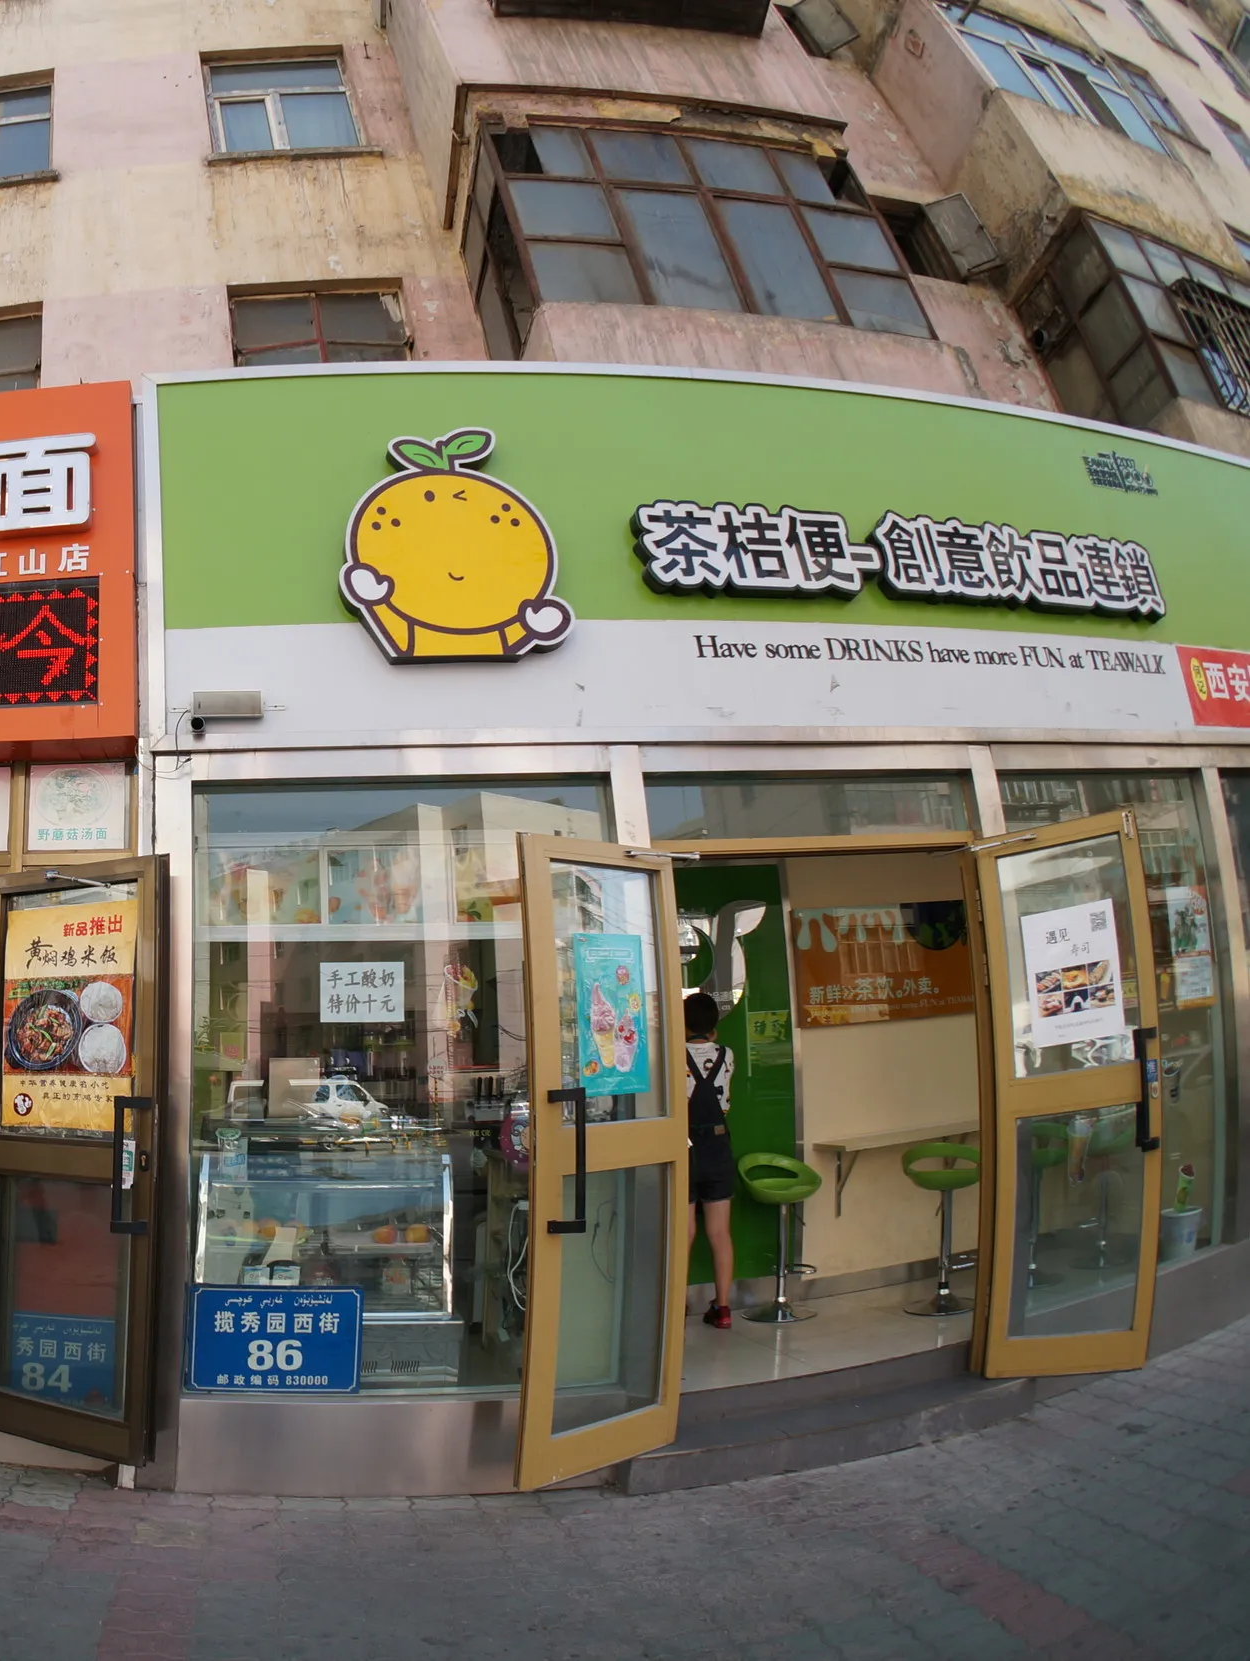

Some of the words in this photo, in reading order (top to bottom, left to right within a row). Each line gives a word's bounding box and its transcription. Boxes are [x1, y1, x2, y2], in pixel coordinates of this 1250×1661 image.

[693, 634, 757, 659] Have
[765, 642, 821, 661] some
[823, 636, 925, 663] DRINKS
[928, 641, 970, 665] have
[974, 649, 1018, 667] more
[1019, 645, 1065, 669] FUN
[1067, 652, 1085, 670] at
[1085, 649, 1166, 675] TEAWALK
[1202, 661, 1250, 702] 西安
[37, 827, 108, 842] 野蘑菇汤面
[62, 914, 123, 937] 新品推出
[1046, 928, 1070, 945] 遇见
[25, 936, 118, 969] 黄焖鸡米饭
[1070, 941, 1090, 957] 寿司
[326, 968, 395, 989] 手工酸奶
[326, 993, 396, 1014] 特价十元
[214, 1310, 341, 1334] 揽秀园西街
[16, 1336, 107, 1363] 秀园西街
[246, 1339, 303, 1371] 86
[21, 1362, 72, 1393] 84
[216, 1372, 280, 1387] 邮政编码
[285, 1374, 329, 1387] 830000
